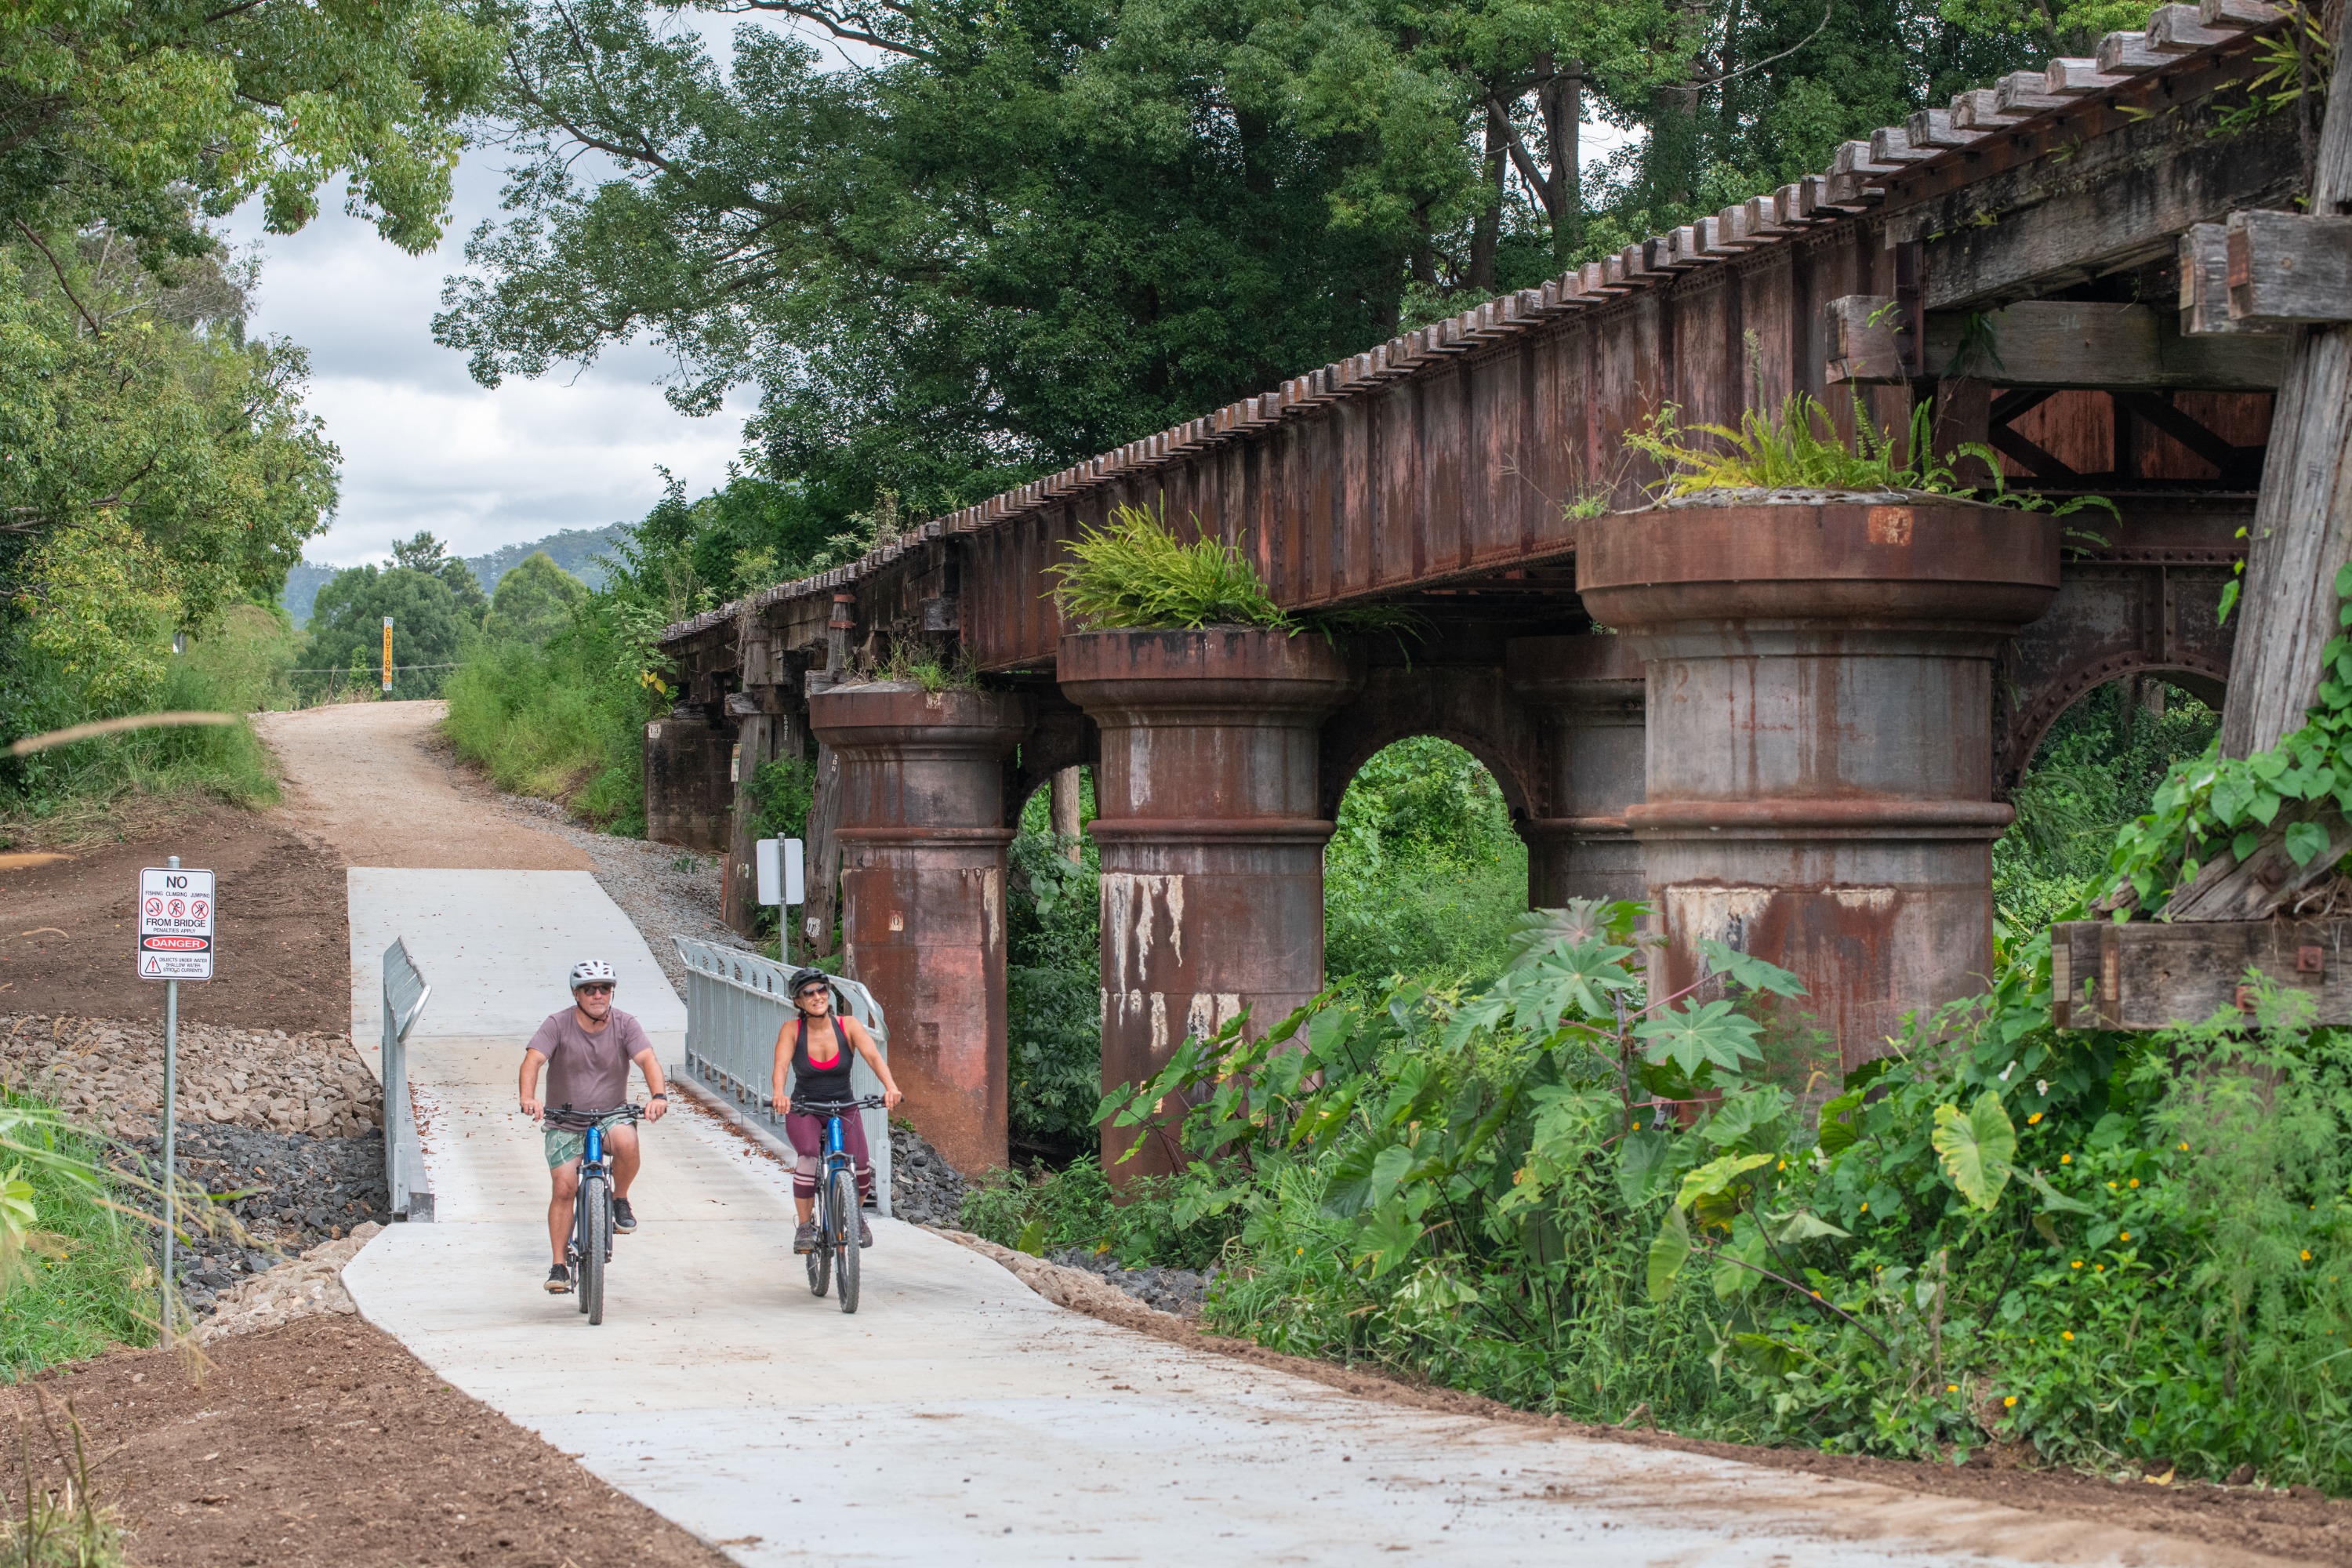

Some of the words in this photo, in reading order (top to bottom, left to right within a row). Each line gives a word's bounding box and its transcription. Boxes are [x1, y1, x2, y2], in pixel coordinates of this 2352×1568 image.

[166, 876, 187, 889] NO
[146, 918, 172, 927] FROM
[174, 919, 206, 927] BRIDGE
[152, 938, 201, 948] DANGER
